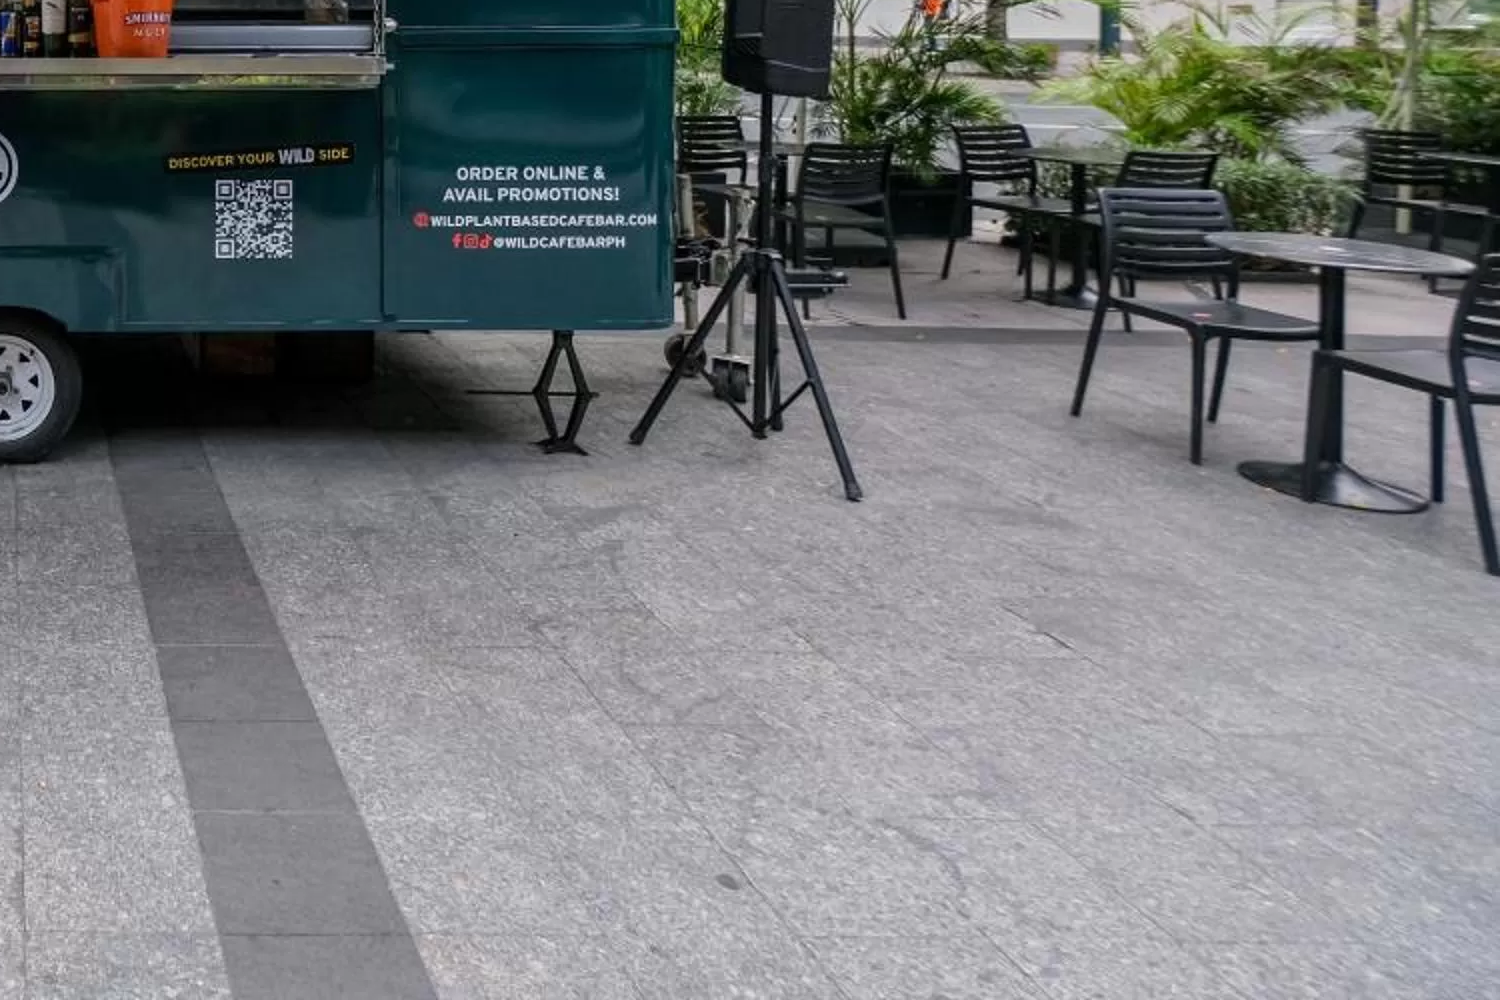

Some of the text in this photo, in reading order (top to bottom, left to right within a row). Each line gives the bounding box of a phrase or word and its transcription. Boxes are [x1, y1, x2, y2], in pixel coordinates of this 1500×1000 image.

[168, 147, 350, 169] DISCOVER YOUR WILD SIDE
[456, 166, 606, 181] ORDER ONLINE &
[442, 187, 620, 202] AVAIL PROMOTIONS!
[431, 213, 657, 227] WILDPLANTBASEDCAFEBAR.COM
[494, 236, 626, 248] @WILDCAFEBARPH
